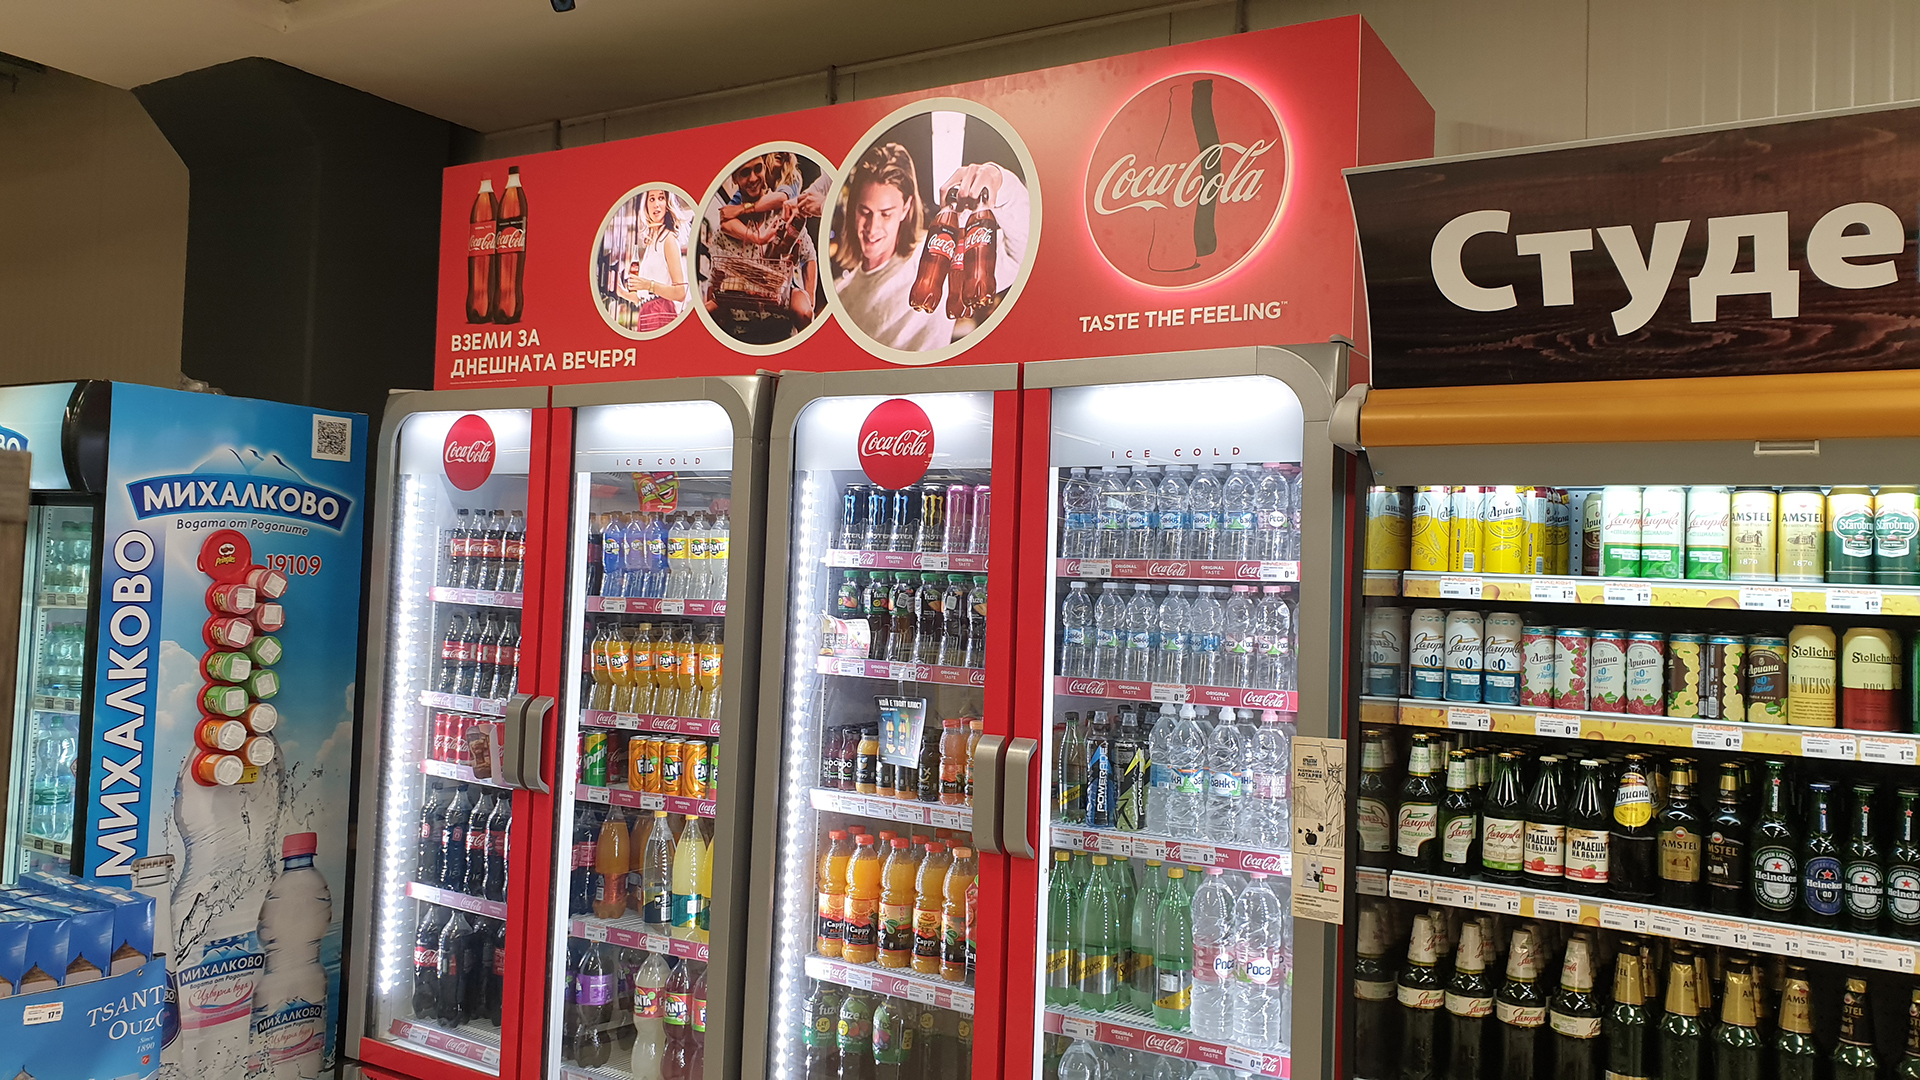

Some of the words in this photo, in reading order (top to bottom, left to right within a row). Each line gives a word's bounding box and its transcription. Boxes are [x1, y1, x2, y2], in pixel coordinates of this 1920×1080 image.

[1093, 137, 1279, 216] Coca-Cola
[1431, 203, 1920, 337] Студе
[1079, 312, 1139, 333] TASTE
[1145, 310, 1184, 327] THE
[451, 330, 512, 352] ВЗЕМИ
[517, 328, 540, 347] ЗА
[450, 352, 557, 379] ДНЕШНАТА
[562, 348, 637, 370] ВЕЧЕРЯ
[861, 429, 931, 457] Coca-Cola
[445, 440, 493, 464] Coca-Cola
[1111, 449, 1151, 459] ICE
[1173, 446, 1241, 457] COLD
[616, 457, 643, 467] ICE
[657, 456, 702, 466] COLD
[142, 481, 340, 523] МИХАЛКОВО
[1488, 505, 1522, 521] Ариана
[1732, 513, 1772, 522] AMSTEL
[1781, 513, 1824, 523] AMSTEL
[176, 518, 223, 533] Водата
[229, 520, 248, 530] от
[251, 519, 309, 537] Родопите
[266, 554, 322, 576] 19109
[1149, 562, 1188, 576] Coca-Cola
[1069, 679, 1107, 695] Coca-Cola
[1800, 676, 1831, 694] WEISS
[95, 529, 156, 878] МИХАЛКОВО
[1242, 691, 1285, 708] Coca-Cola
[652, 717, 678, 731] Coca-Cola
[1485, 823, 1521, 842] Загорка
[1572, 839, 1607, 851] КРАДЕЦЪТ
[1661, 839, 1698, 850] AMSTEL
[1708, 843, 1738, 856] MSTEL
[1571, 850, 1580, 858] НА
[1581, 851, 1606, 860] ЯБЪЛКИ
[1755, 870, 1797, 883] Heineken
[1806, 878, 1843, 890] Heineken
[1845, 883, 1883, 895] Heineken
[849, 926, 870, 936] Cappy
[916, 937, 936, 947] Cappy
[182, 955, 264, 984] МИХАЛКОВО
[1246, 962, 1271, 976] Роса
[87, 984, 165, 1028] TSANT
[665, 1000, 687, 1013] FANTA
[1843, 1005, 1864, 1017] STEL
[258, 1006, 322, 1032] МИХАЛКОВО
[840, 1009, 860, 1020] fuze
[1110, 1028, 1133, 1038] ORIGINAL
[136, 1042, 156, 1054] 1890
[1146, 1035, 1186, 1054] Coca-Cola
[1198, 1046, 1223, 1055] ORIGINAL
